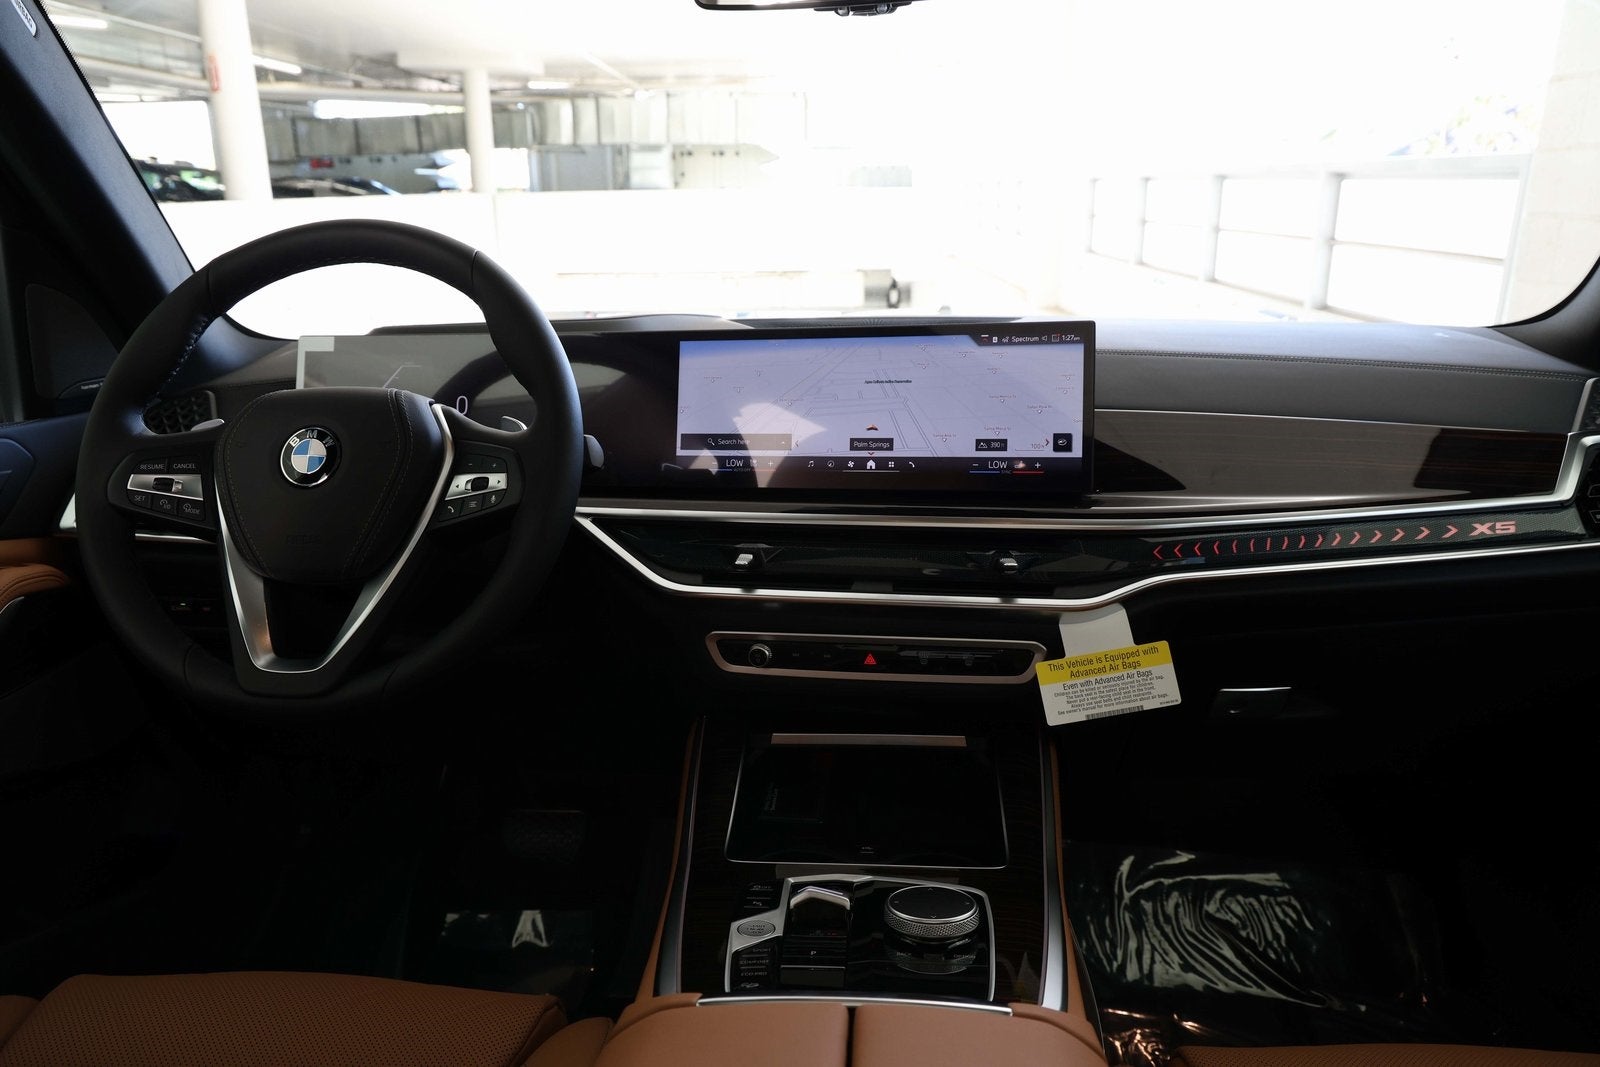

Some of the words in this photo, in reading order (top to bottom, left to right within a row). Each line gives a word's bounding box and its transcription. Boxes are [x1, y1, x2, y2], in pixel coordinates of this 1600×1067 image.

[456, 395, 468, 415] 0
[290, 430, 334, 447] BMW
[871, 440, 890, 450] Springs
[726, 459, 744, 467] LOW
[988, 460, 1008, 469] LOW
[1469, 521, 1516, 535] X5
[1048, 662, 1064, 671] This
[1065, 656, 1093, 668] Vehicle
[1095, 655, 1102, 663] is
[1104, 648, 1140, 663] Equipped
[1141, 645, 1158, 655] with
[1069, 664, 1106, 678] Advanced
[1107, 662, 1119, 671] Air
[1121, 659, 1141, 670] Bags
[1062, 681, 1077, 690] Even
[1079, 679, 1093, 687] with
[1093, 674, 1124, 685] Advanced
[1136, 669, 1152, 678] Bags
